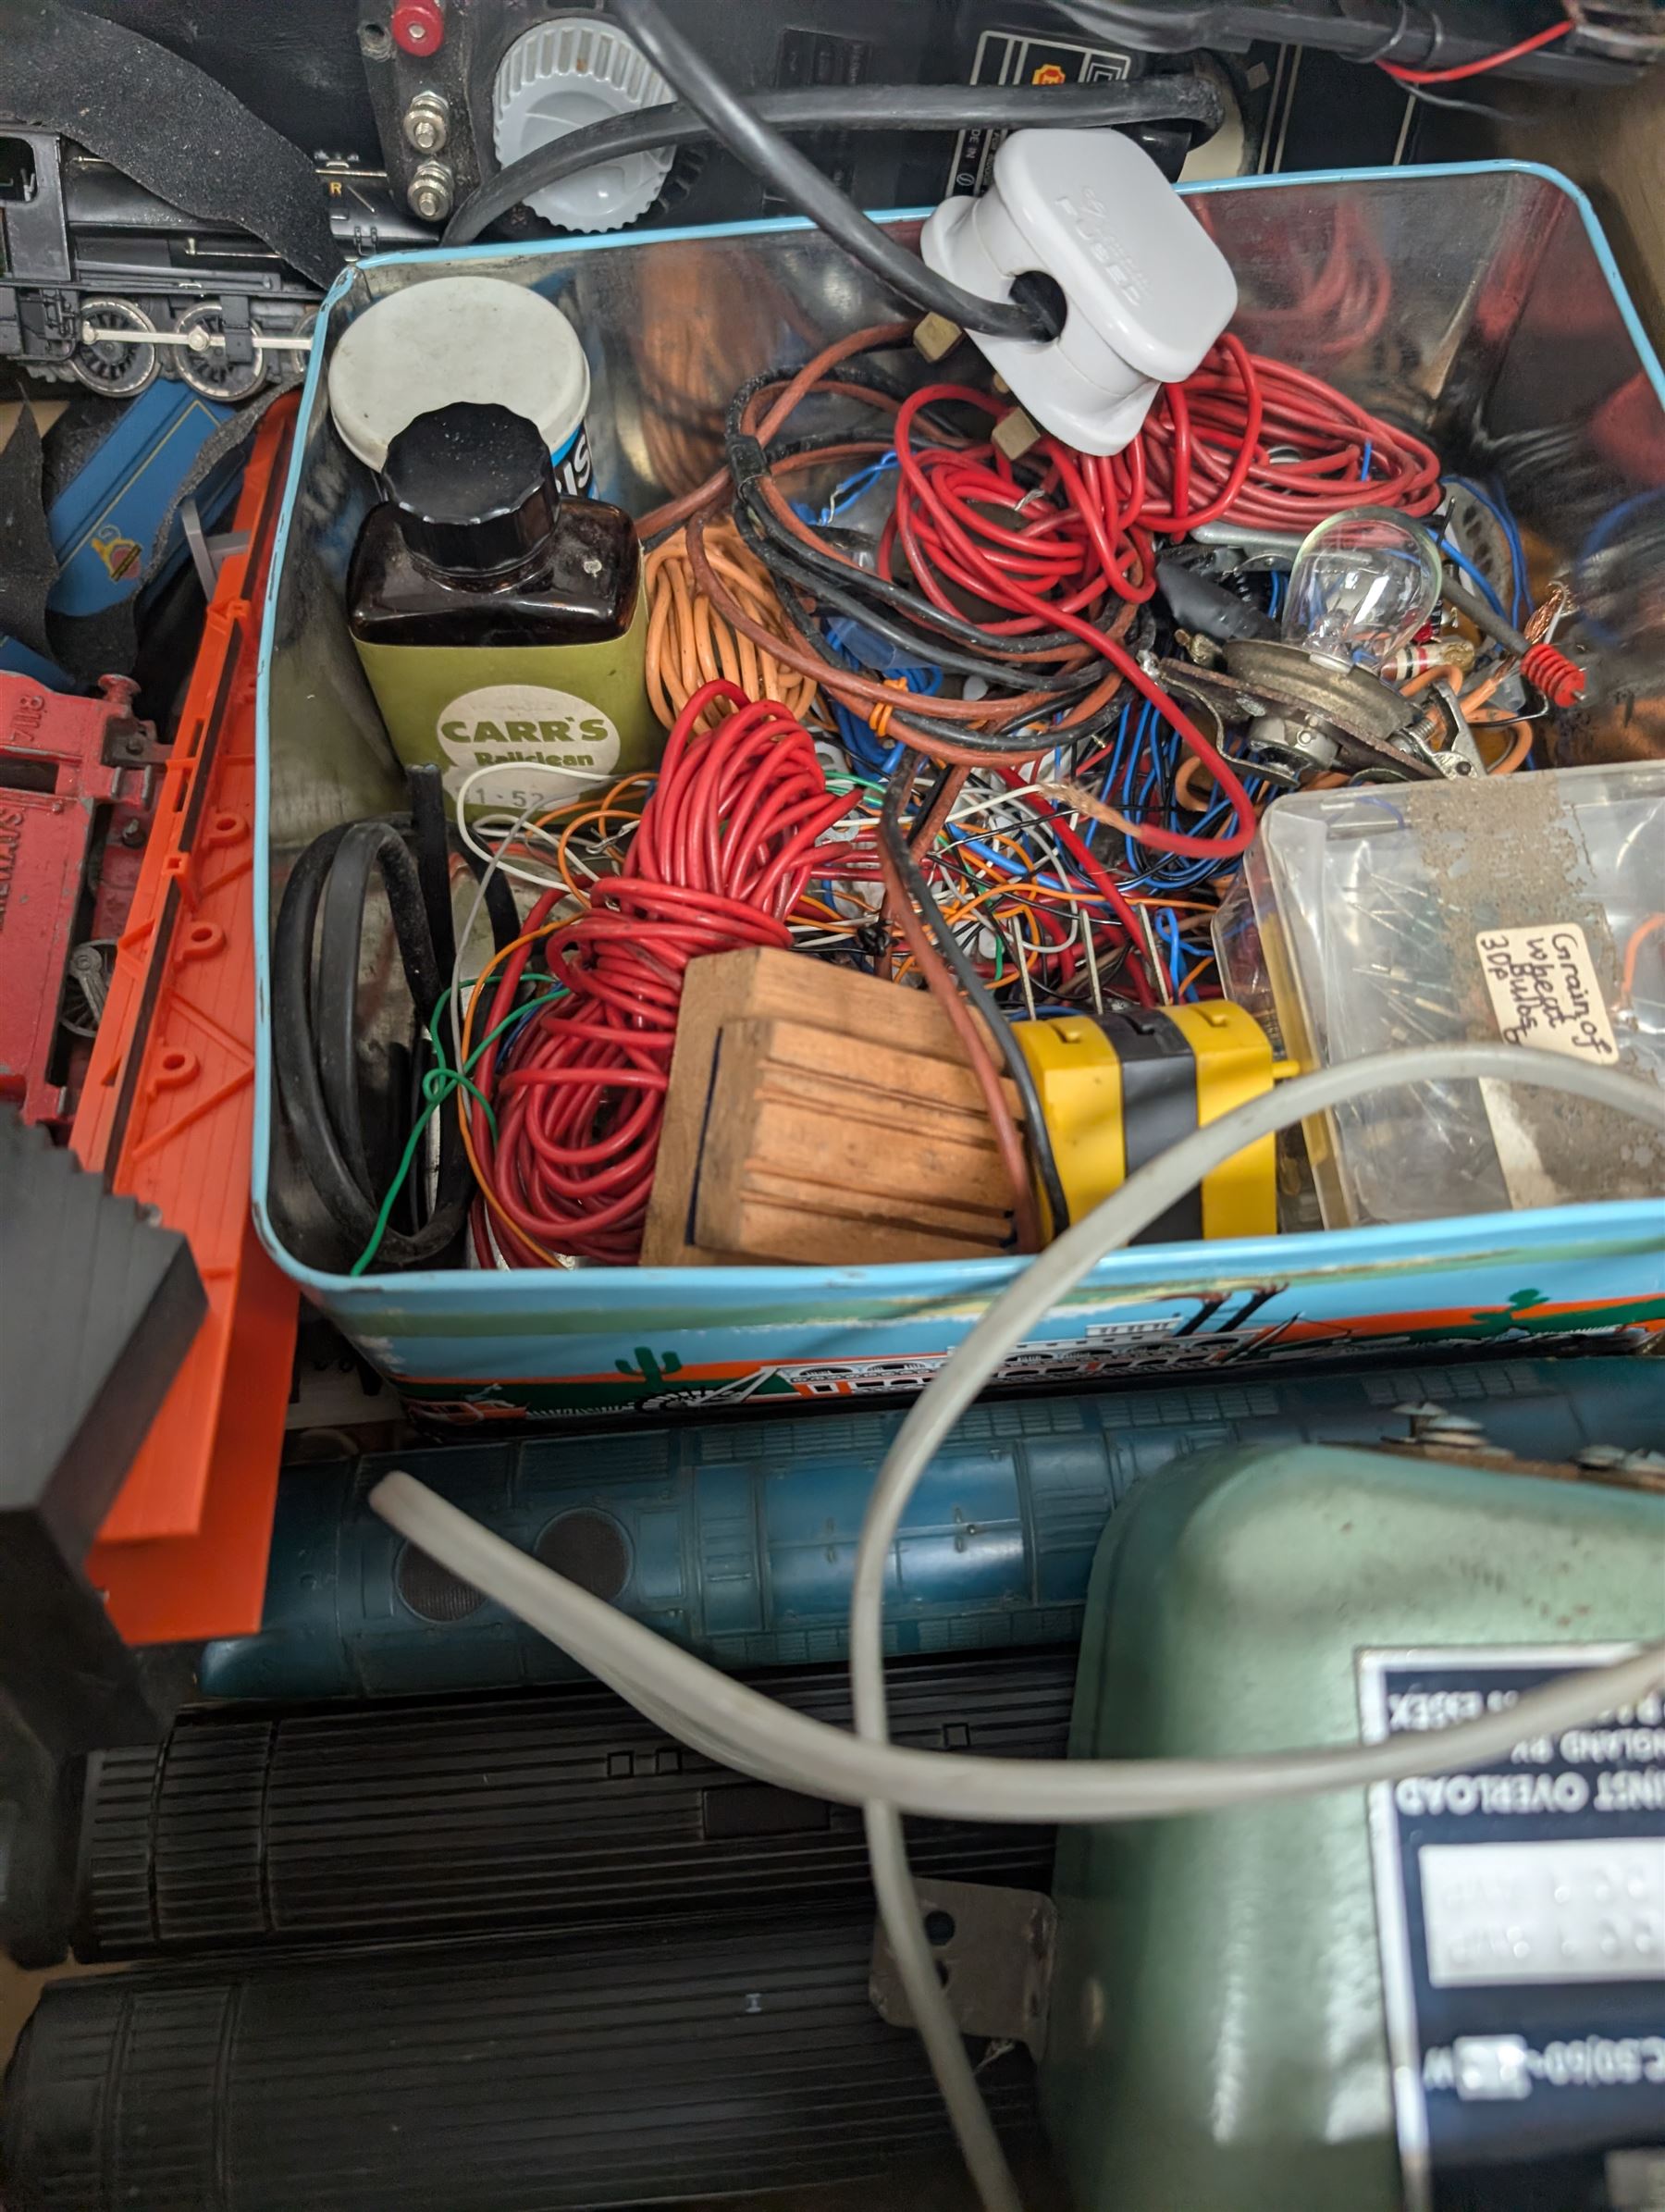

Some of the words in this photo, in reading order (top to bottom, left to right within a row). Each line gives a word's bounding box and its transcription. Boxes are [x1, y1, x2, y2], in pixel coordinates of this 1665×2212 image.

[441, 716, 609, 744] CARR'S
[1552, 933, 1590, 1019] Grain
[1572, 1020, 1612, 1054] of
[1560, 1727, 1665, 1764] NGLAND
[1396, 1771, 1589, 1816] OVERLOAD
